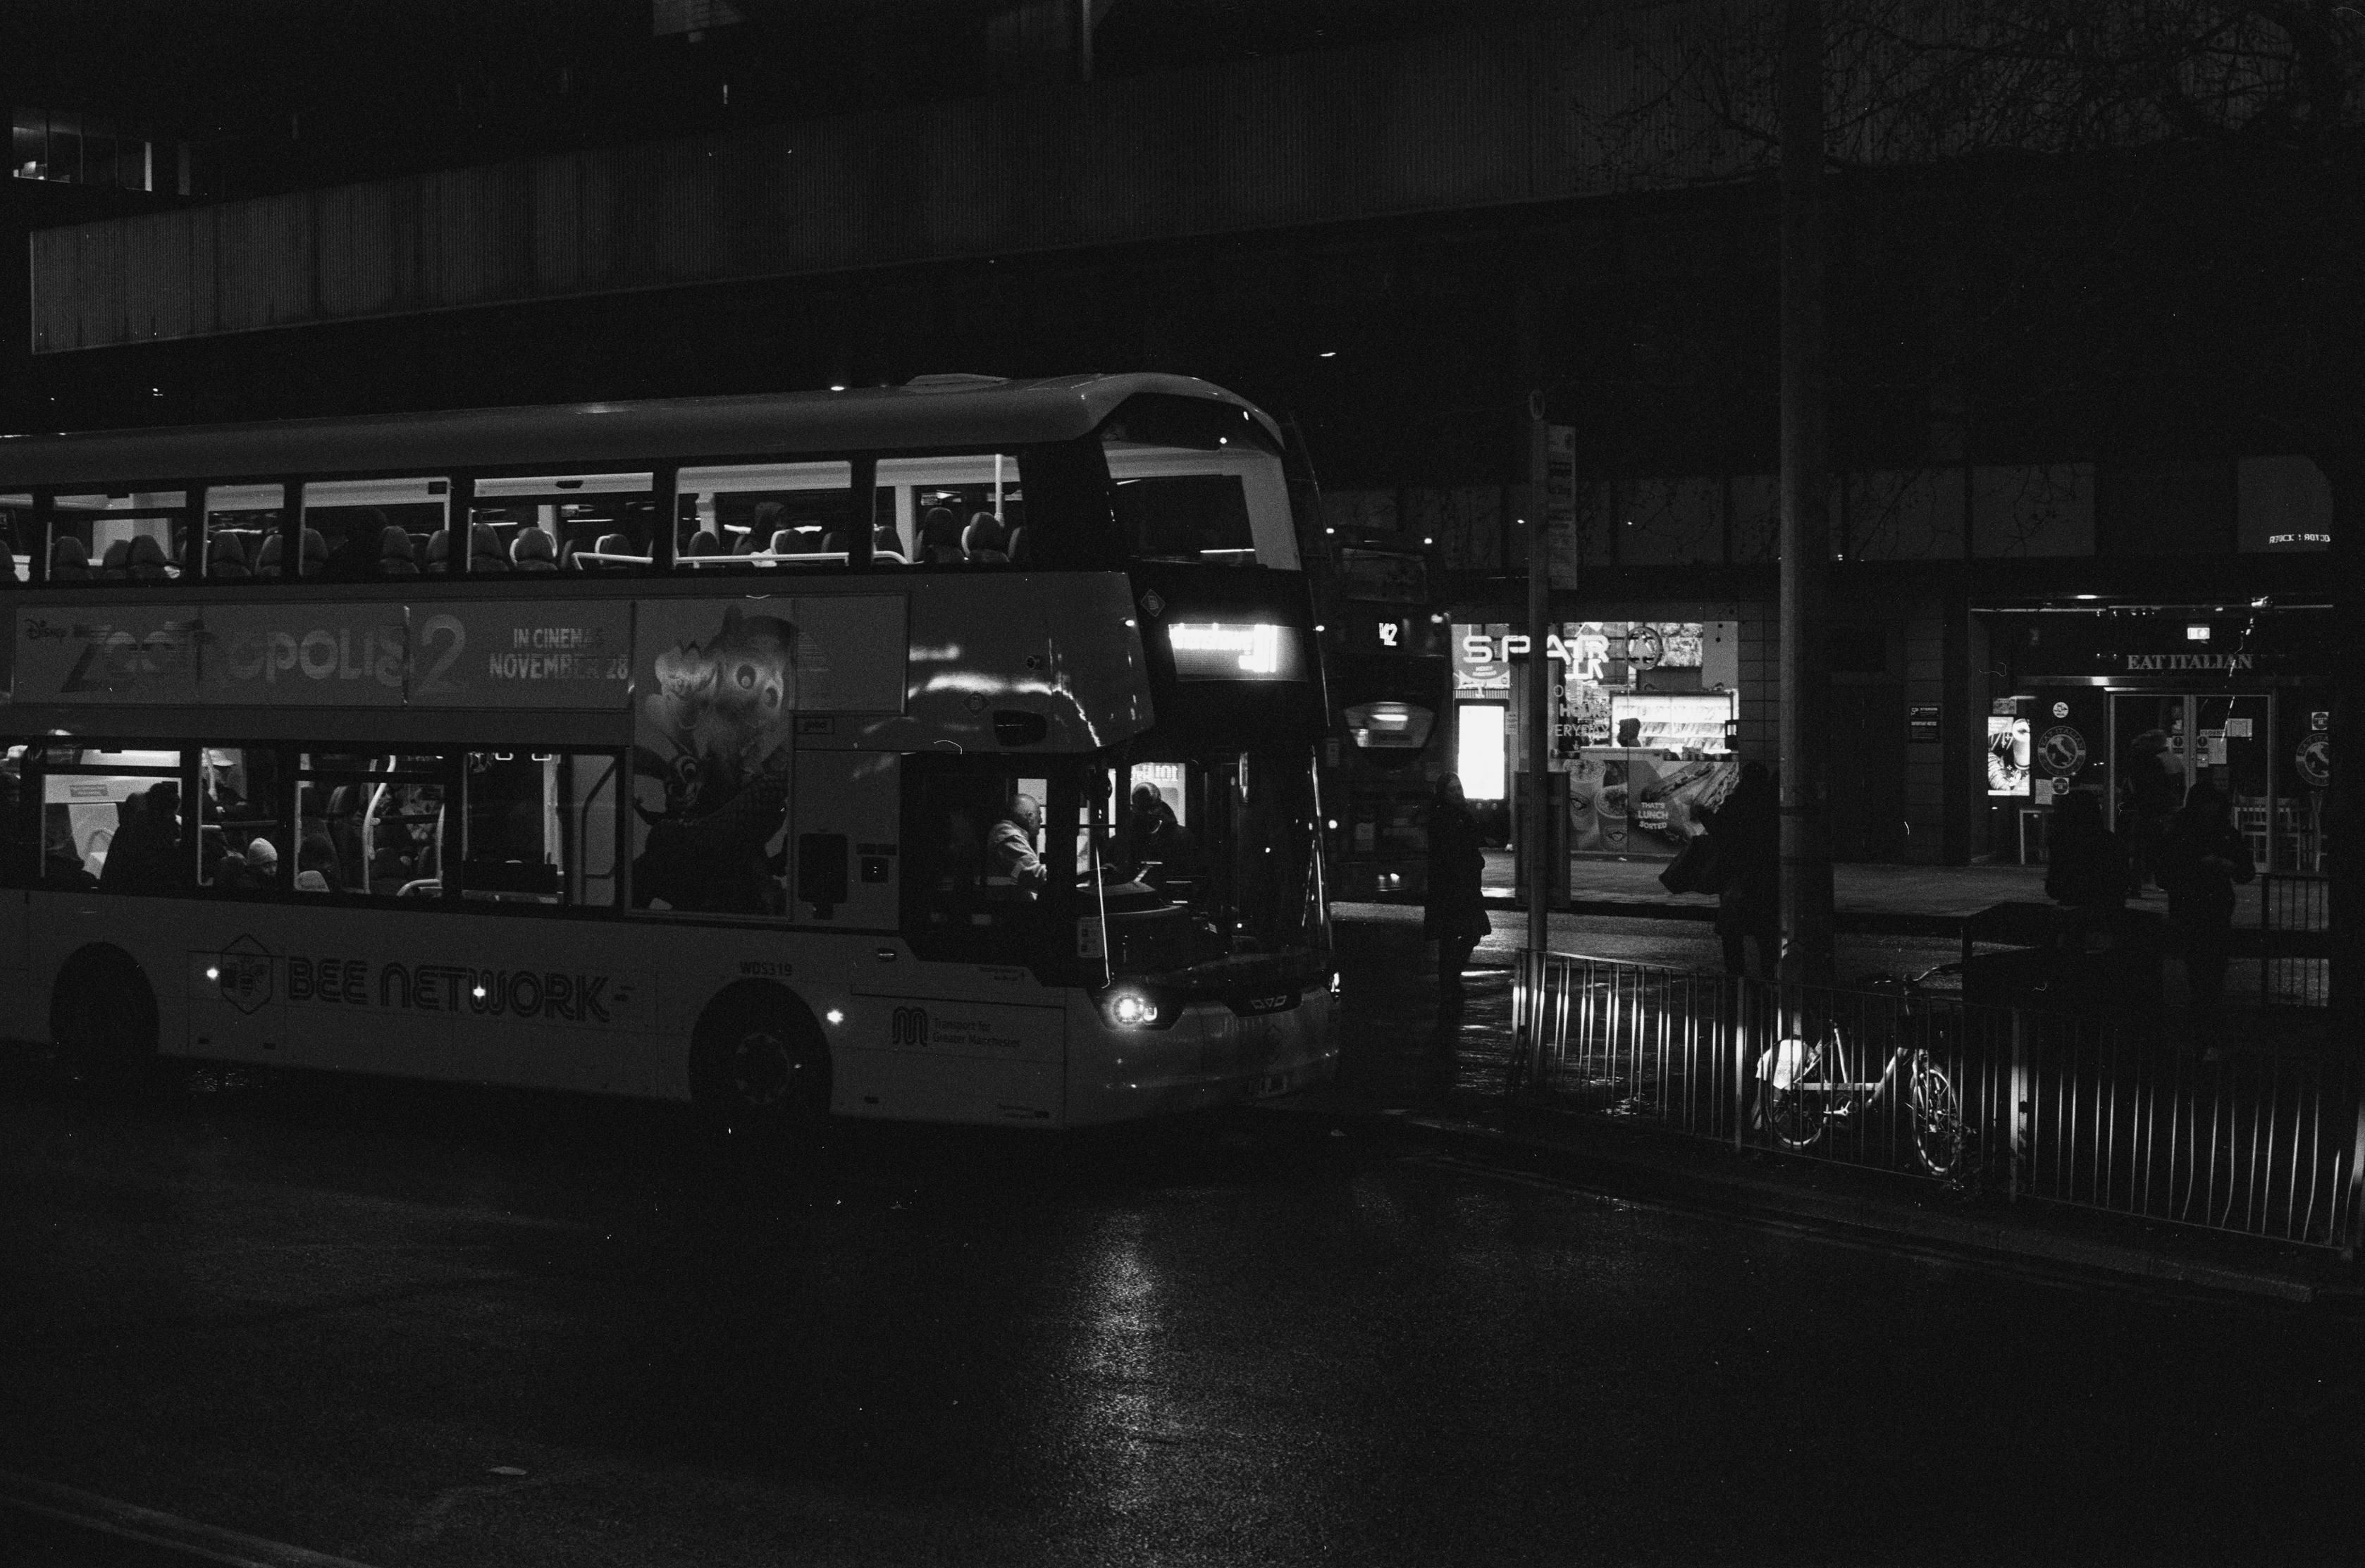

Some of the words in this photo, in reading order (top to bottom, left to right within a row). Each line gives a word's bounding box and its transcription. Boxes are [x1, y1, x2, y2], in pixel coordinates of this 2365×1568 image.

[513, 628, 529, 648] IN
[414, 612, 468, 696] 2
[1462, 634, 1610, 664] SPAR
[606, 654, 629, 680] 28
[2127, 654, 2166, 669] EAT
[2168, 654, 2253, 669] ITALIAN
[1638, 810, 1669, 819] LUNCH
[1639, 820, 1667, 829] SORTED
[288, 956, 368, 1004] BEE
[380, 961, 611, 1023] NETWORK
[934, 1018, 975, 1032] Transport
[932, 1031, 965, 1044] Greater
